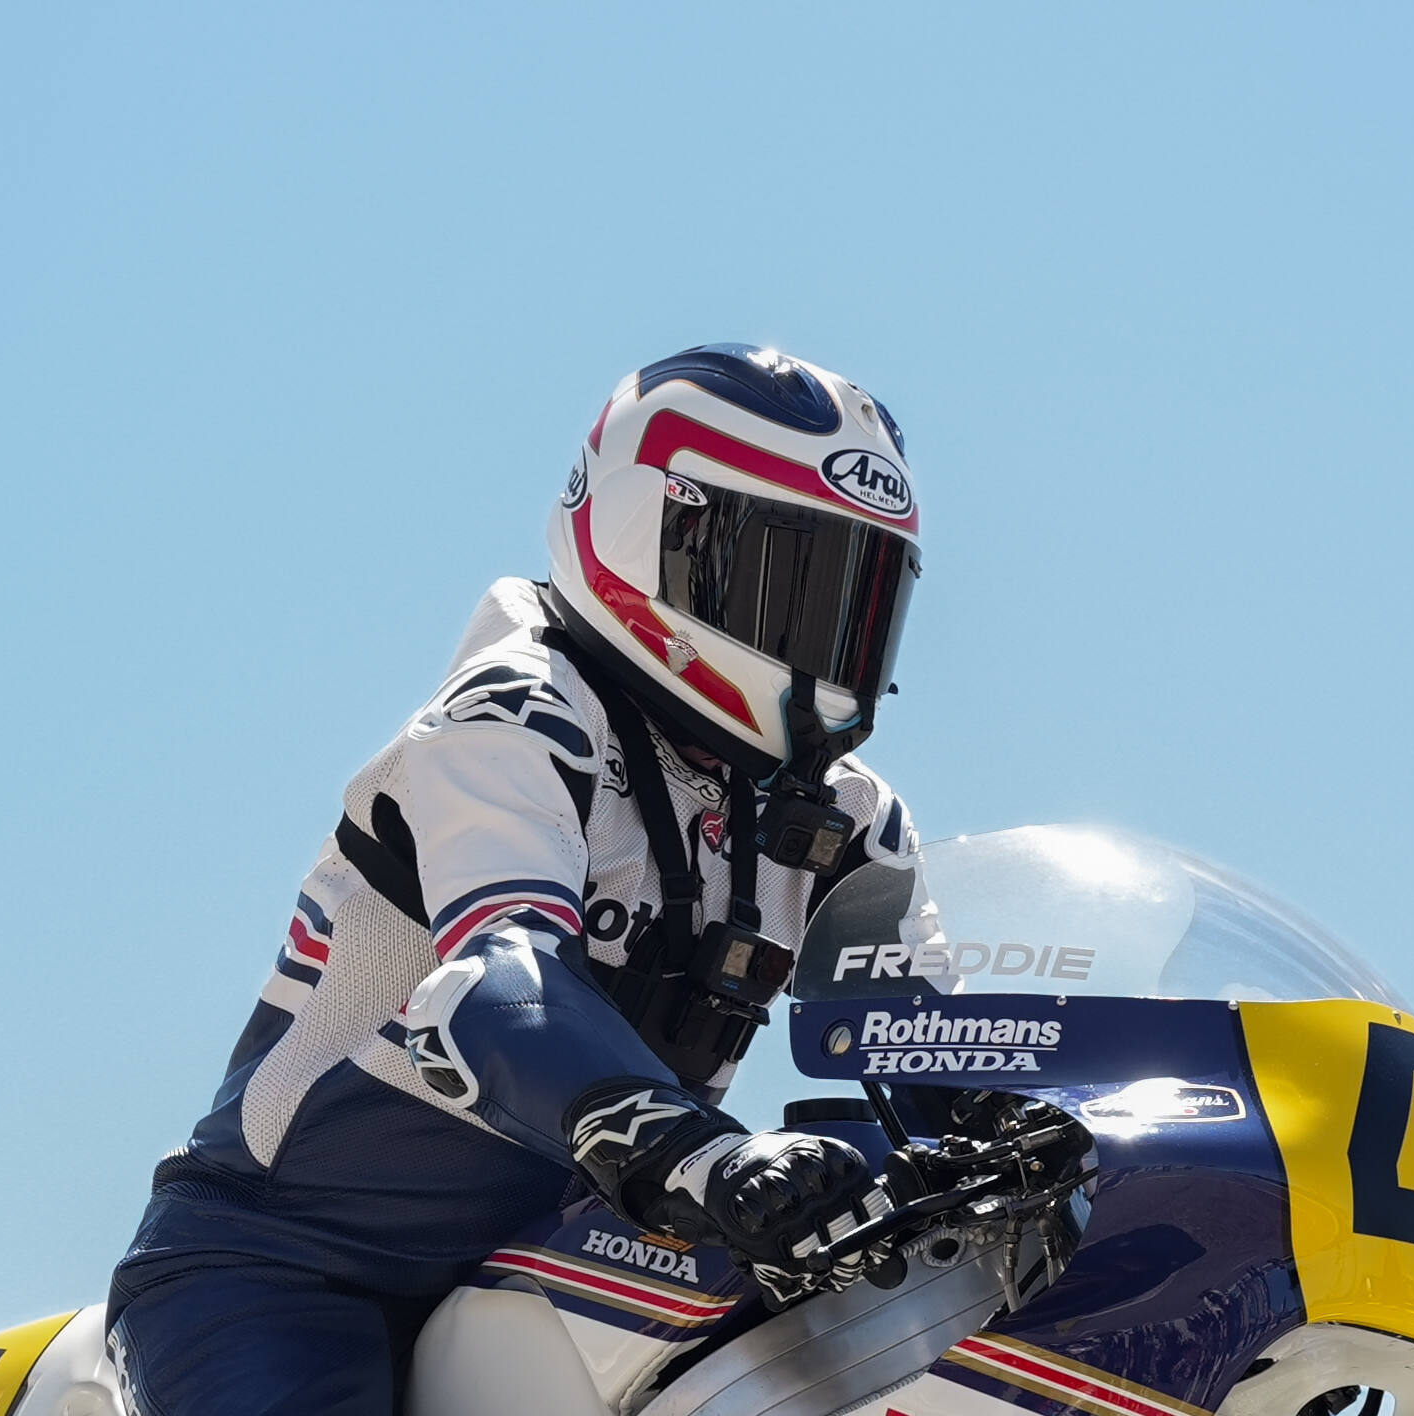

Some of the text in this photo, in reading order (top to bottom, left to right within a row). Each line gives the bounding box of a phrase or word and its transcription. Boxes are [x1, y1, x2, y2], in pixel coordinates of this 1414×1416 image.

[830, 454, 906, 503] Arai
[859, 489, 895, 508] HELMET
[833, 942, 1096, 982] FREDDIE
[860, 1011, 1062, 1047] Rothmans
[863, 1050, 1042, 1075] HONDA
[582, 1229, 699, 1284] HONDA
